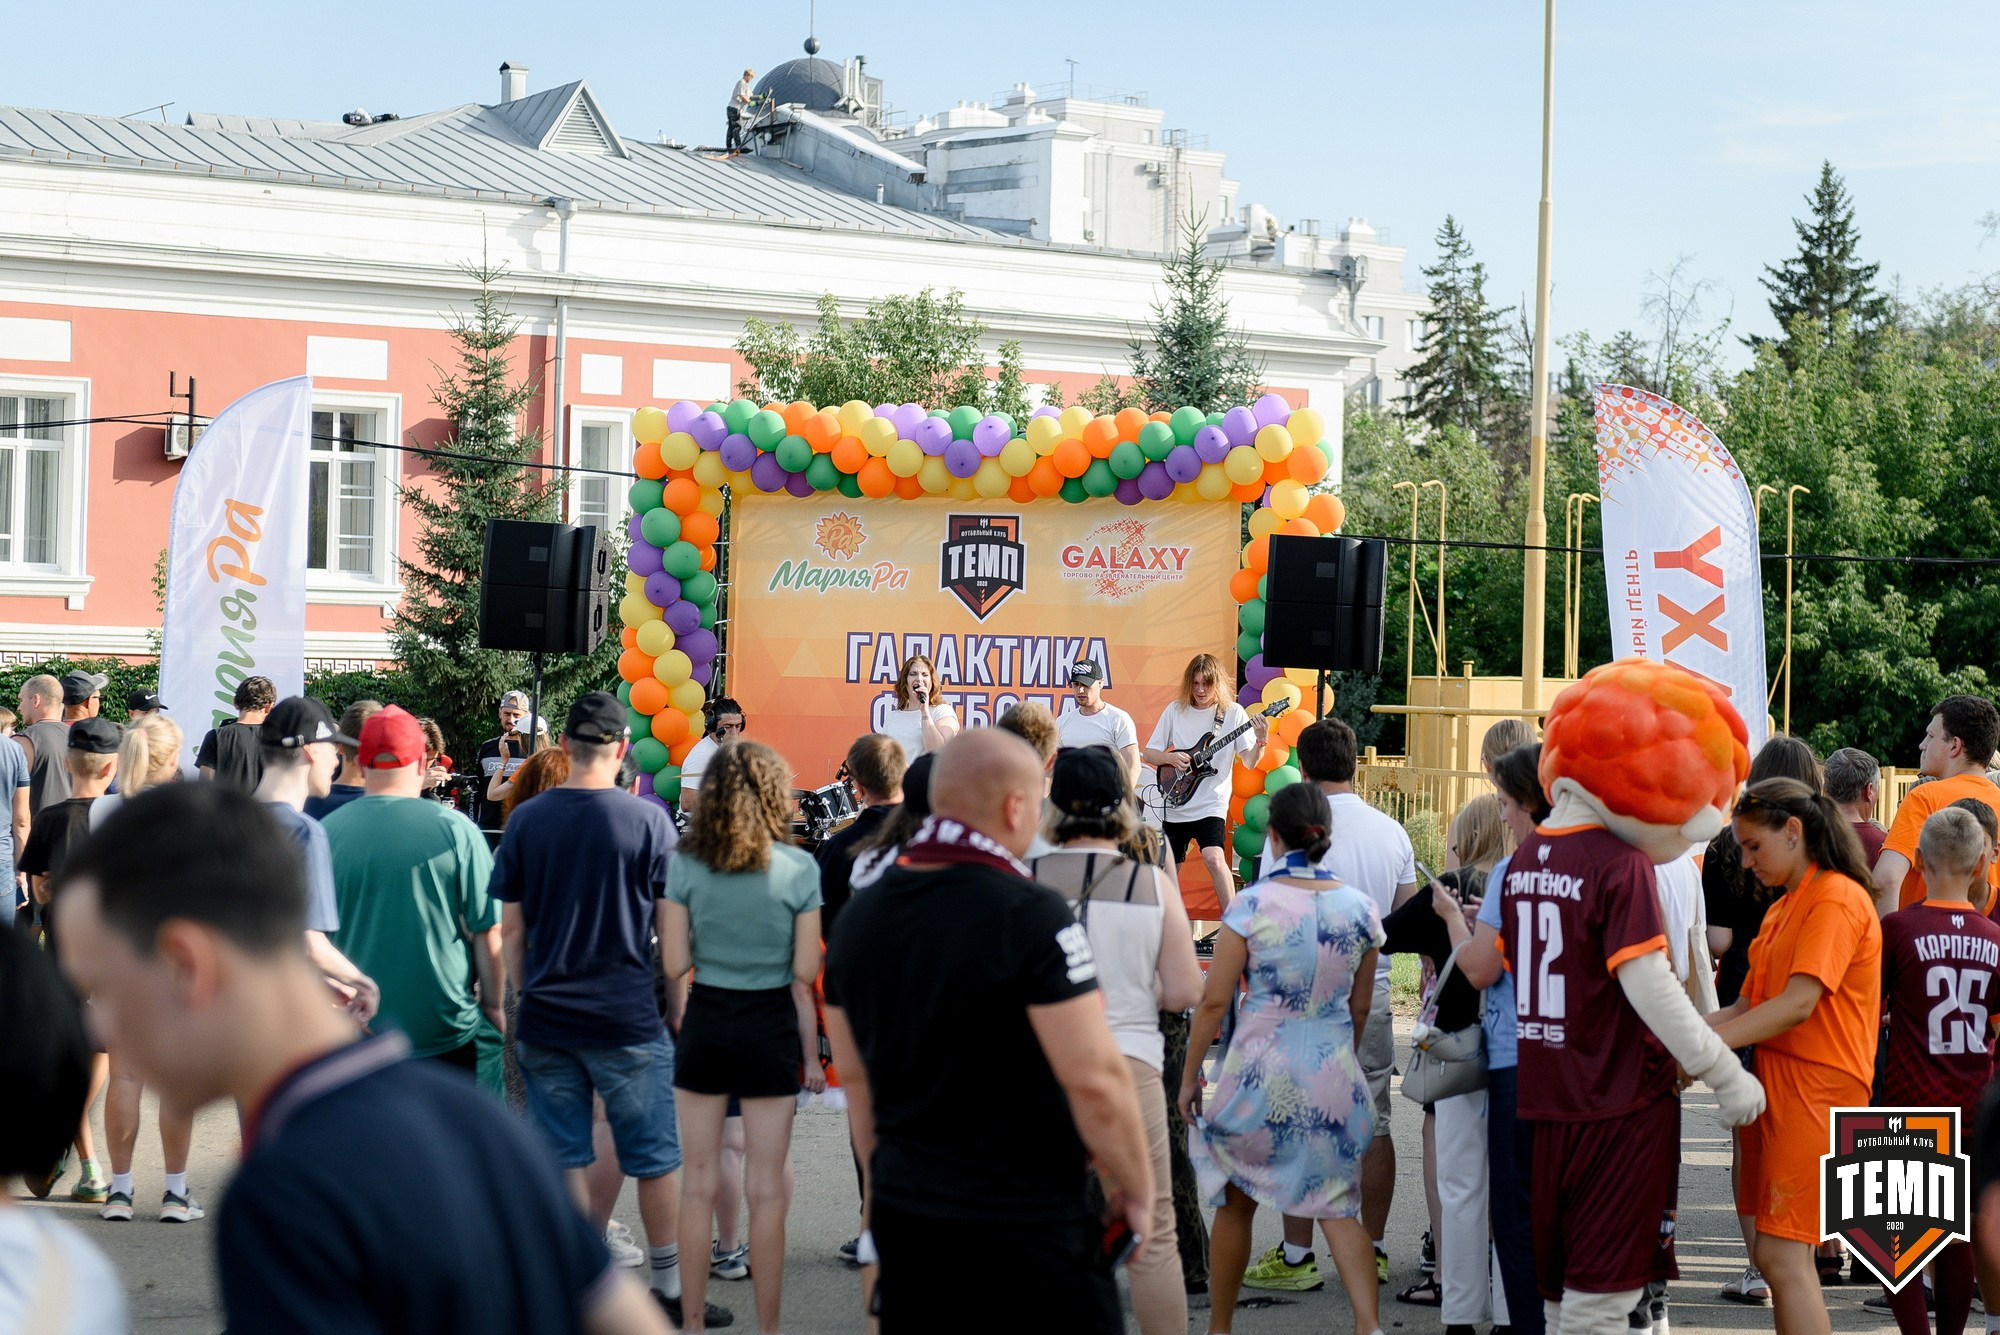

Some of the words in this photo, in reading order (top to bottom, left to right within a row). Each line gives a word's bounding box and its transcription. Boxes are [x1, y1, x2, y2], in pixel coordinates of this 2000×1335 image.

[948, 543, 1019, 583] ТЕМП
[1062, 545, 1191, 571] GALAXY
[1516, 901, 1565, 1019] 12
[1914, 934, 1999, 968] КАРПЕНКО
[1926, 966, 1992, 1055] 25
